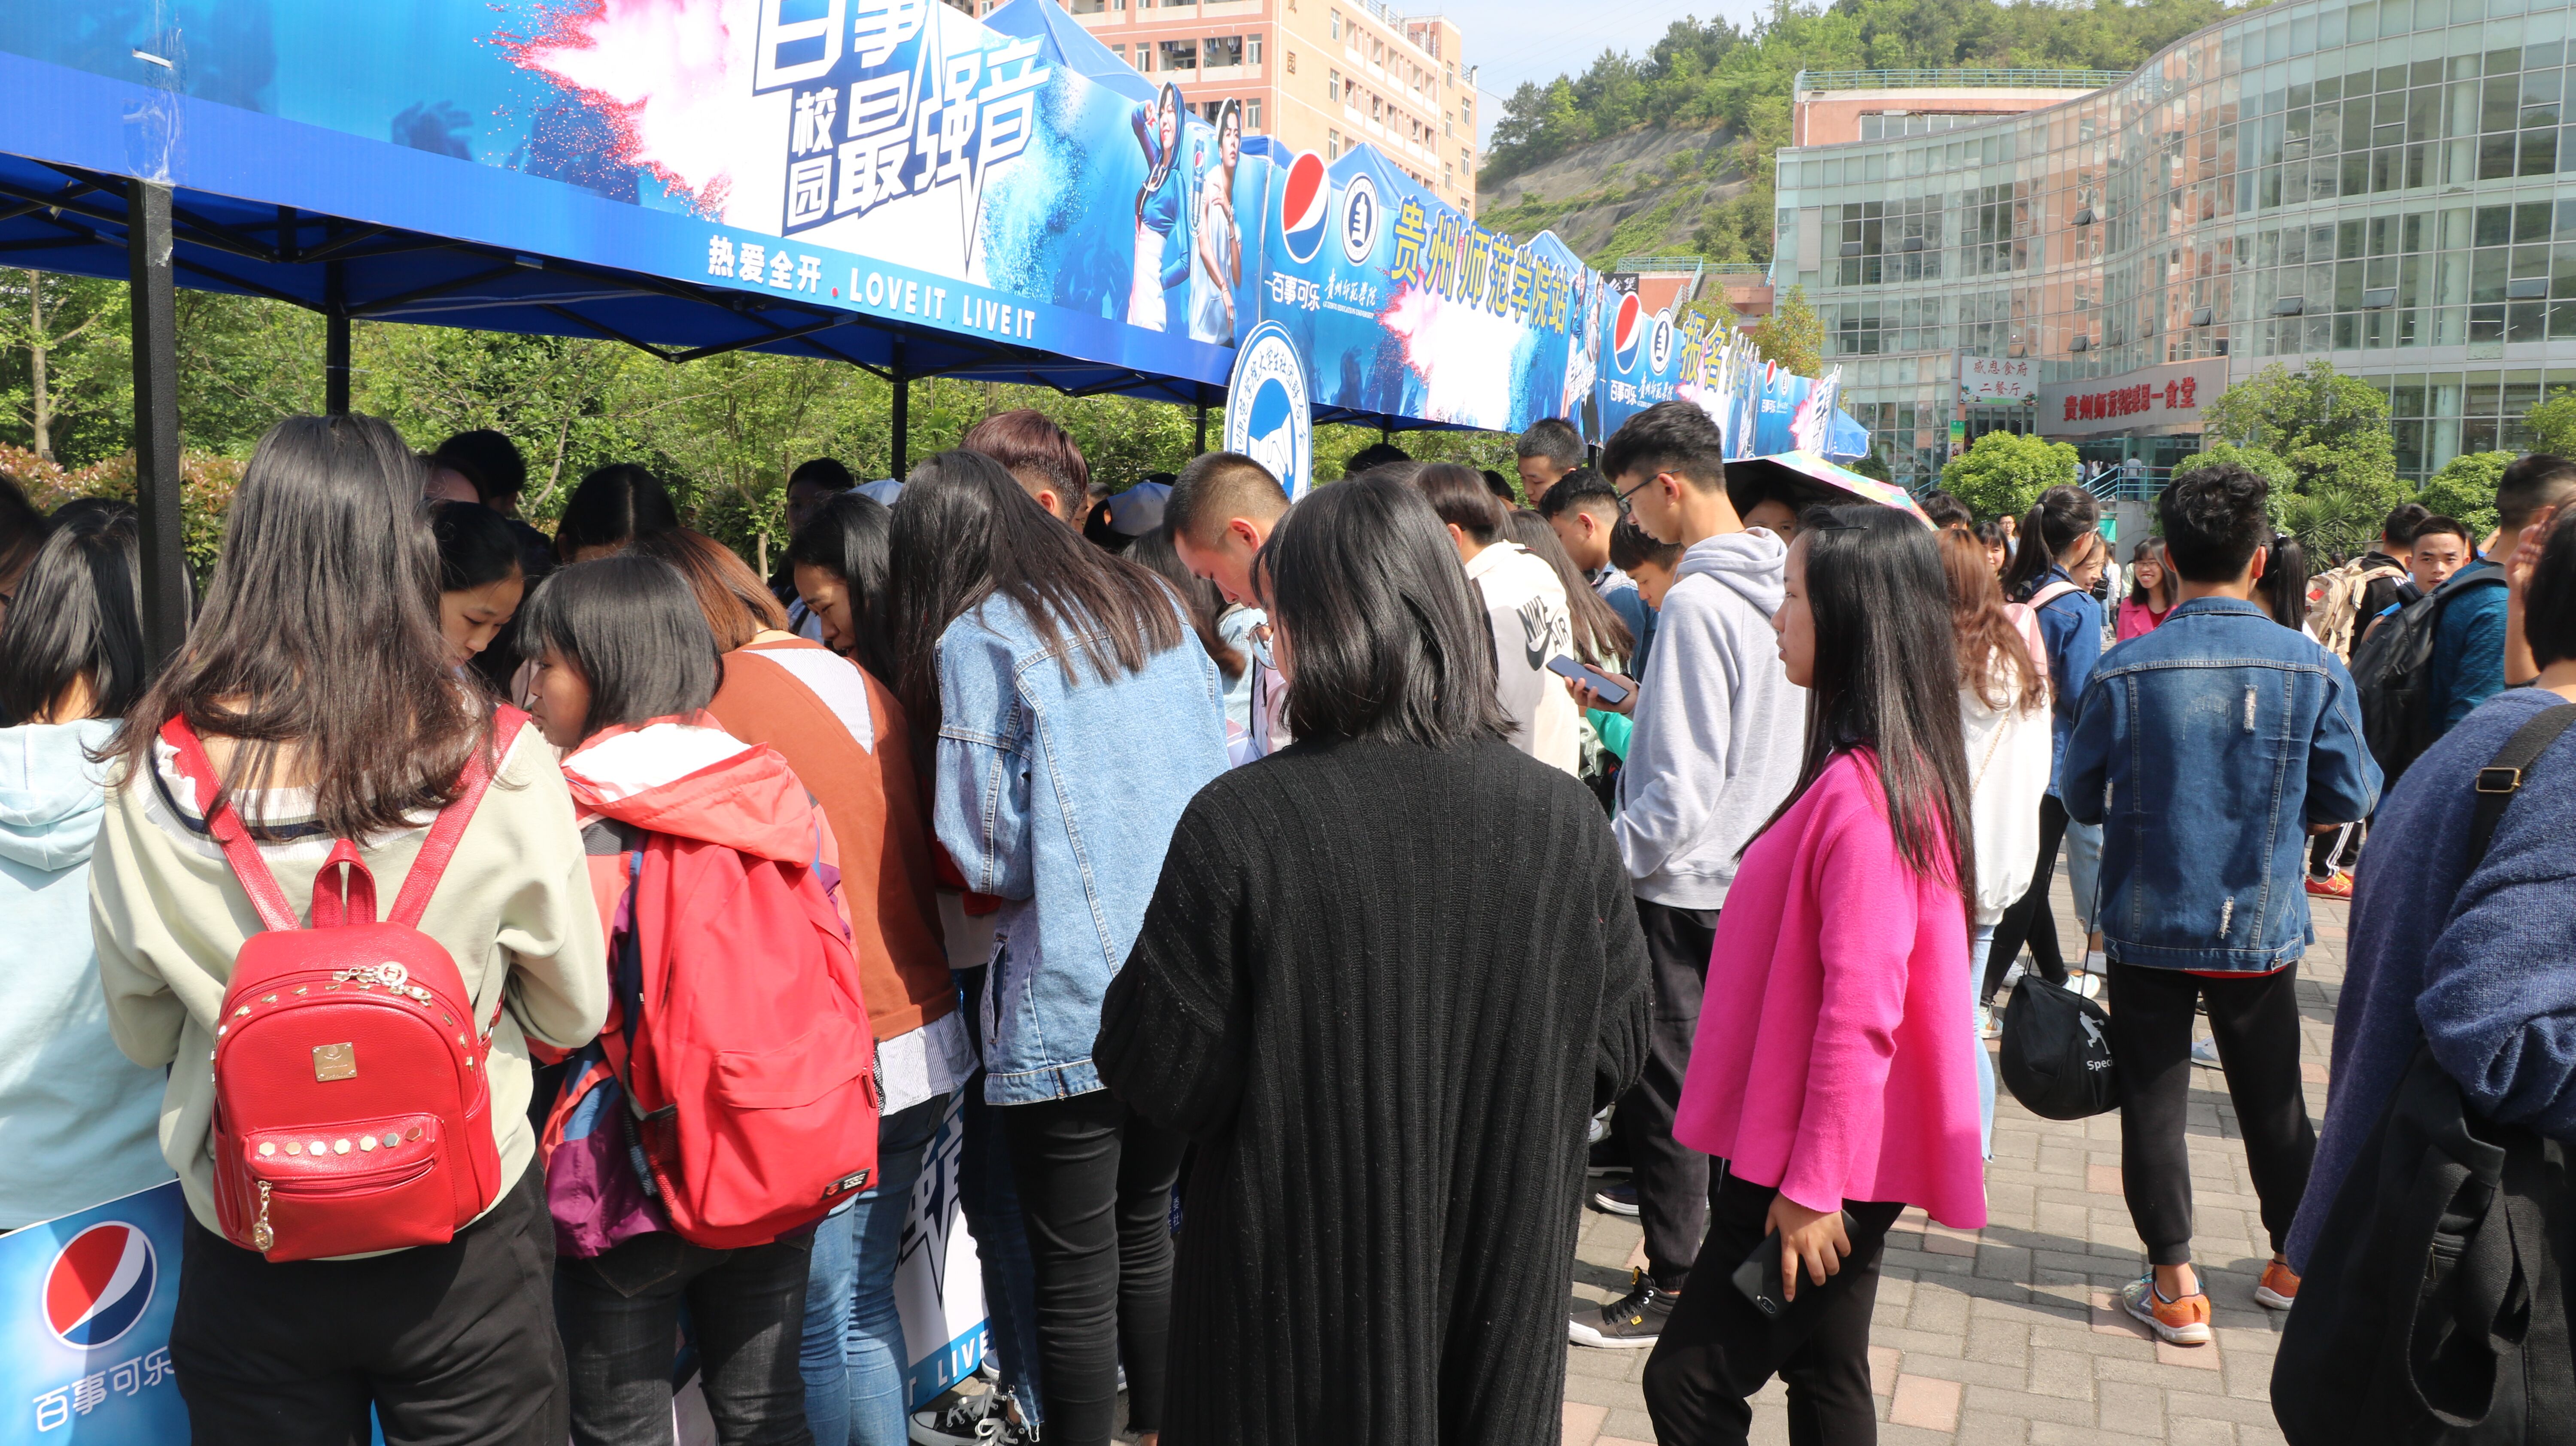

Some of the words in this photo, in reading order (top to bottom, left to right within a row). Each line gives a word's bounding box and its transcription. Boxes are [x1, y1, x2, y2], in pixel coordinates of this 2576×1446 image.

[787, 87, 838, 228] 校园
[833, 39, 1052, 219] 最强音
[708, 234, 821, 293] 热爱全开
[1272, 271, 1320, 311] 百事可乐
[1391, 200, 1568, 335] 贵州师范学院站
[850, 267, 916, 314] LOVE
[924, 288, 946, 320] IT
[963, 295, 1011, 336] LIVE
[1017, 310, 1035, 340] IT
[1611, 380, 1637, 405] 百事可乐
[1974, 359, 2028, 376] 感恩食府
[1980, 381, 2020, 396] 二餐厅
[1235, 345, 1306, 452] 师范学院大学生社团联合会
[2063, 377, 2196, 421] 贵州师范学院感恩一食堂
[1516, 595, 1547, 643] NIKE
[1552, 617, 1570, 653] AIR
[938, 1329, 989, 1388] LIVE
[33, 1346, 175, 1432] 百事可乐
